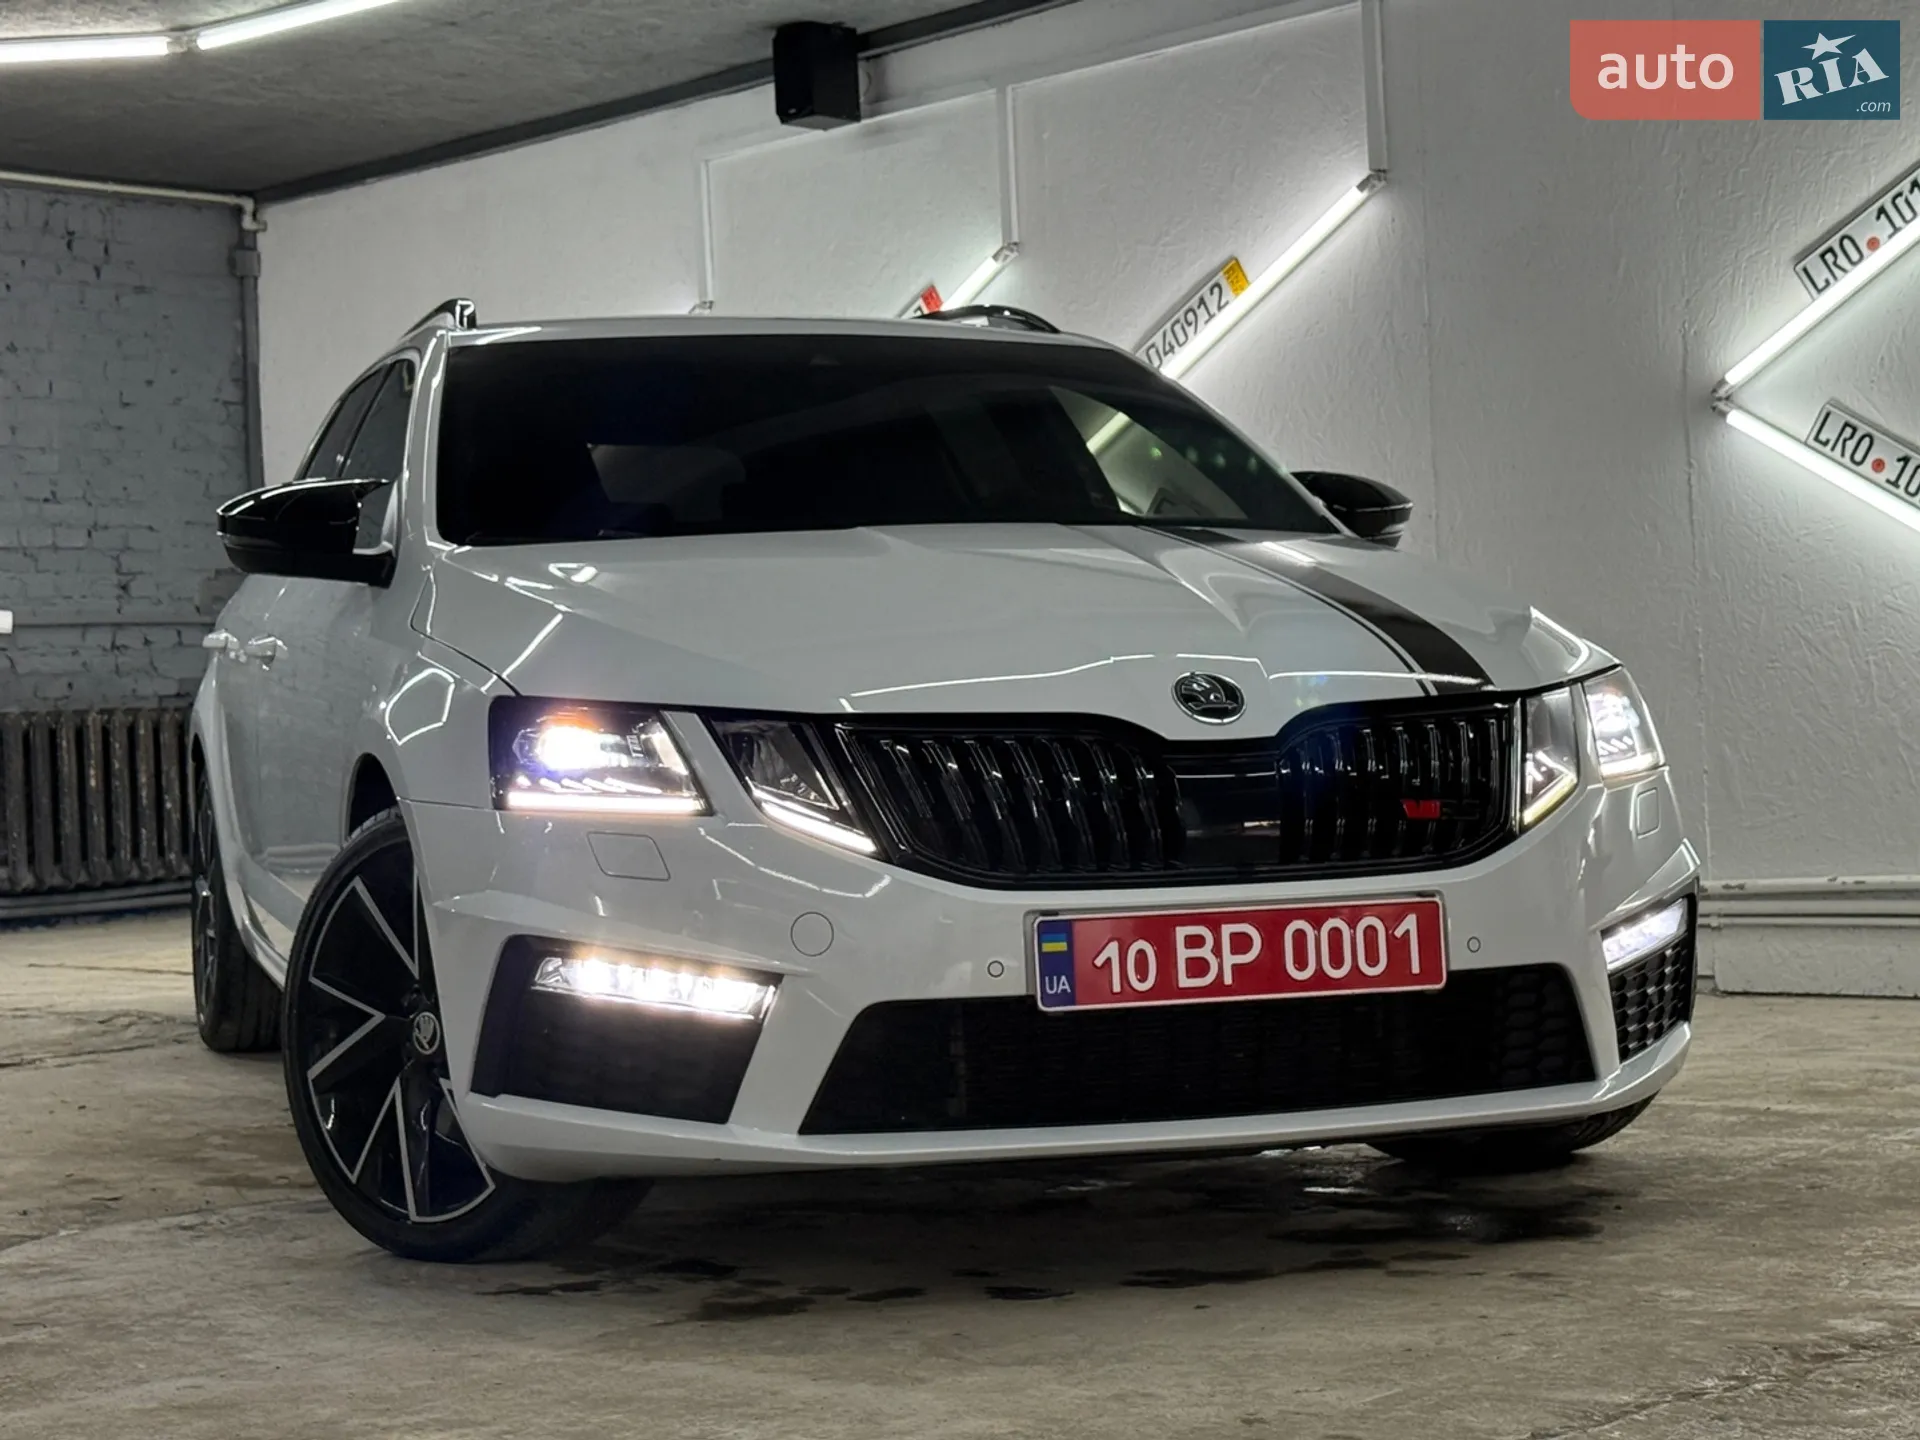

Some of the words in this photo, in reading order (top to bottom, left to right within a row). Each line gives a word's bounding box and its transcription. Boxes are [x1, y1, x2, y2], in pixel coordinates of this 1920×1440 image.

[1801, 233, 1865, 294] LRO
[1812, 410, 1875, 467] LRO
[1093, 939, 1158, 994] 10
[1175, 922, 1262, 989] BP
[1283, 912, 1422, 982] 0001
[1045, 975, 1071, 995] UA
